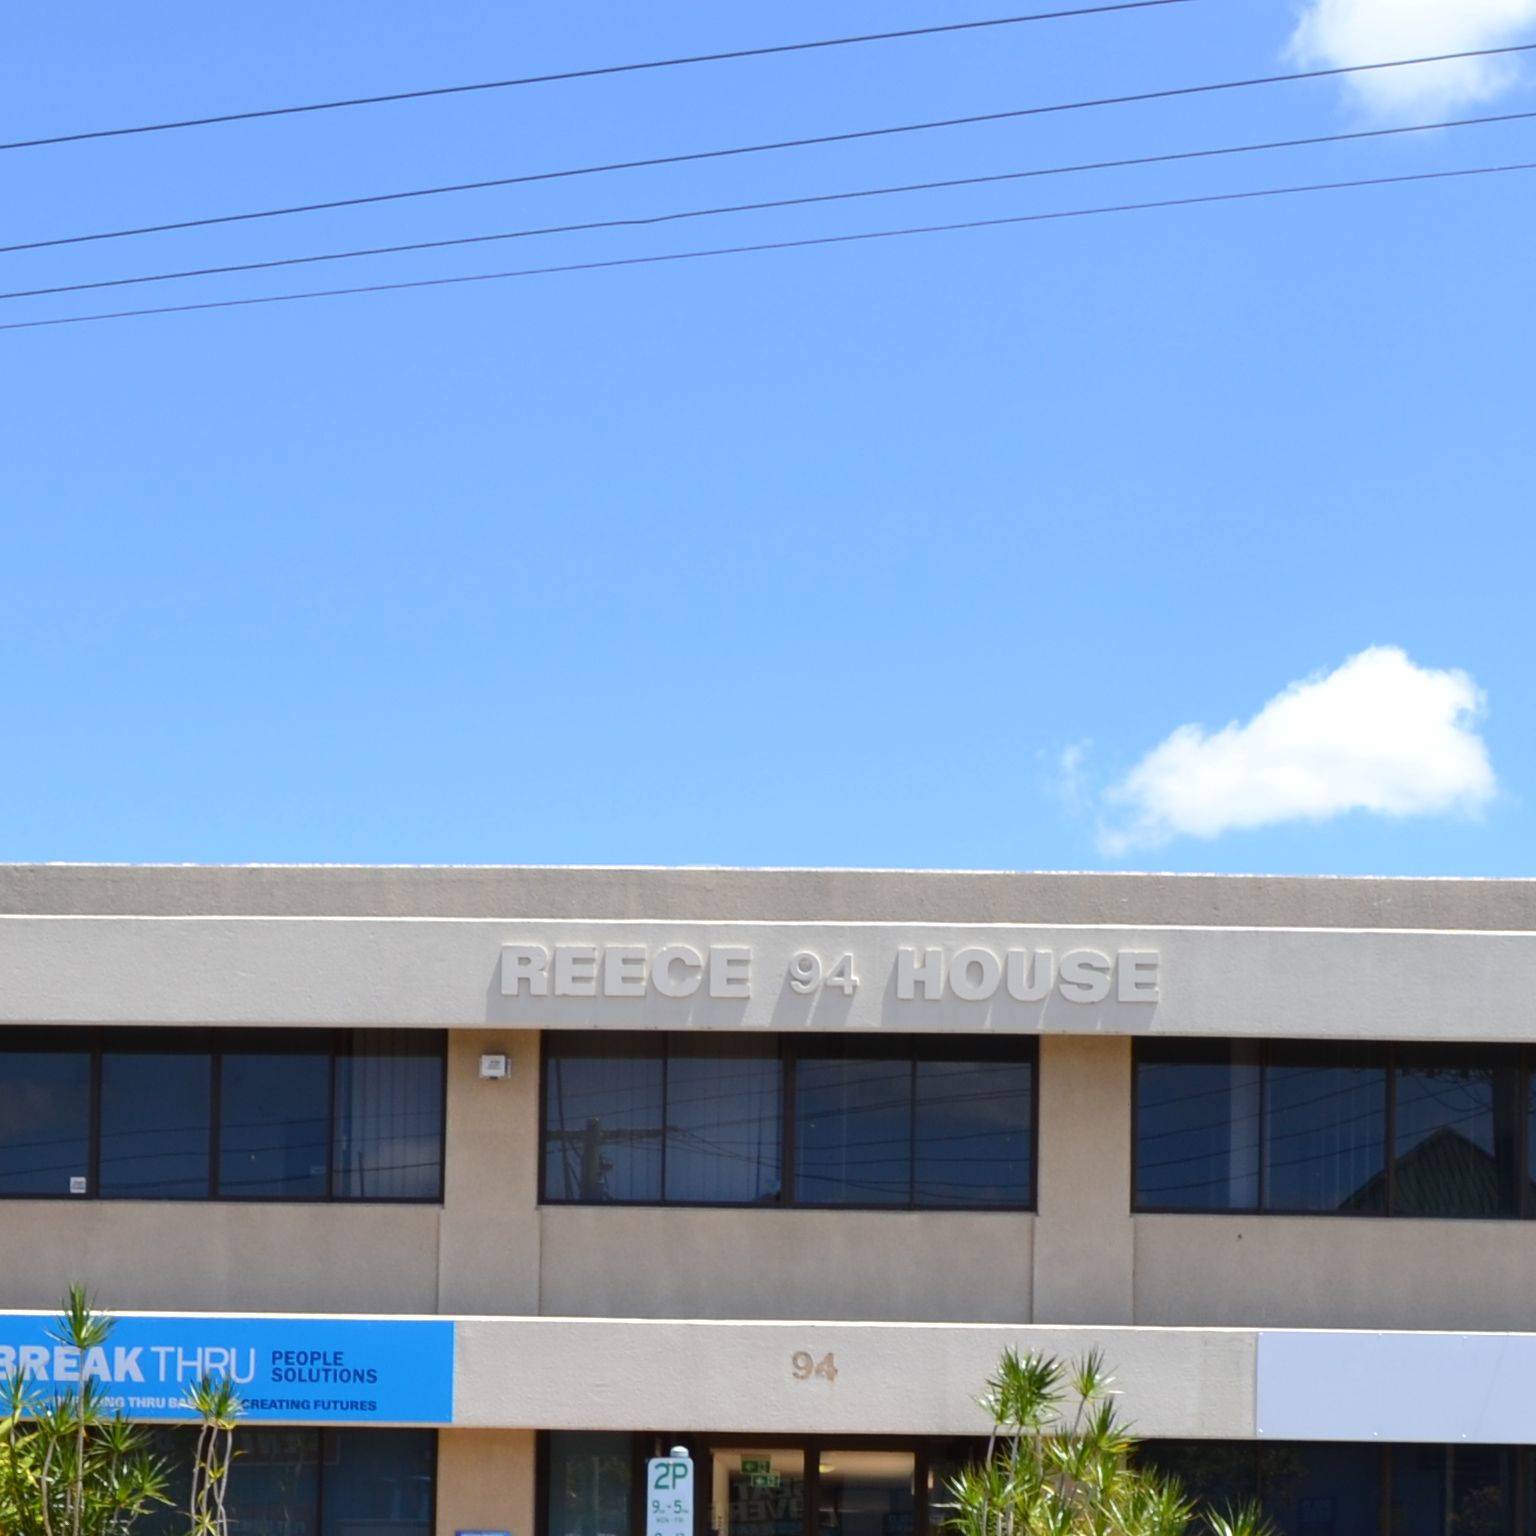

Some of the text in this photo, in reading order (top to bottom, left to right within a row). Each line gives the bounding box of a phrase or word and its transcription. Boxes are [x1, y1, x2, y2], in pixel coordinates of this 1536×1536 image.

[500, 944, 1161, 1003] REECE 94 HOUSE
[150, 1347, 256, 1384] THRU
[271, 1350, 344, 1368] PEOPLE
[271, 1367, 378, 1385] SOLUTIONS
[792, 1351, 838, 1381] 94
[129, 1397, 165, 1408] THRU
[313, 1399, 377, 1411] FUTURES
[654, 1463, 688, 1490] 2P
